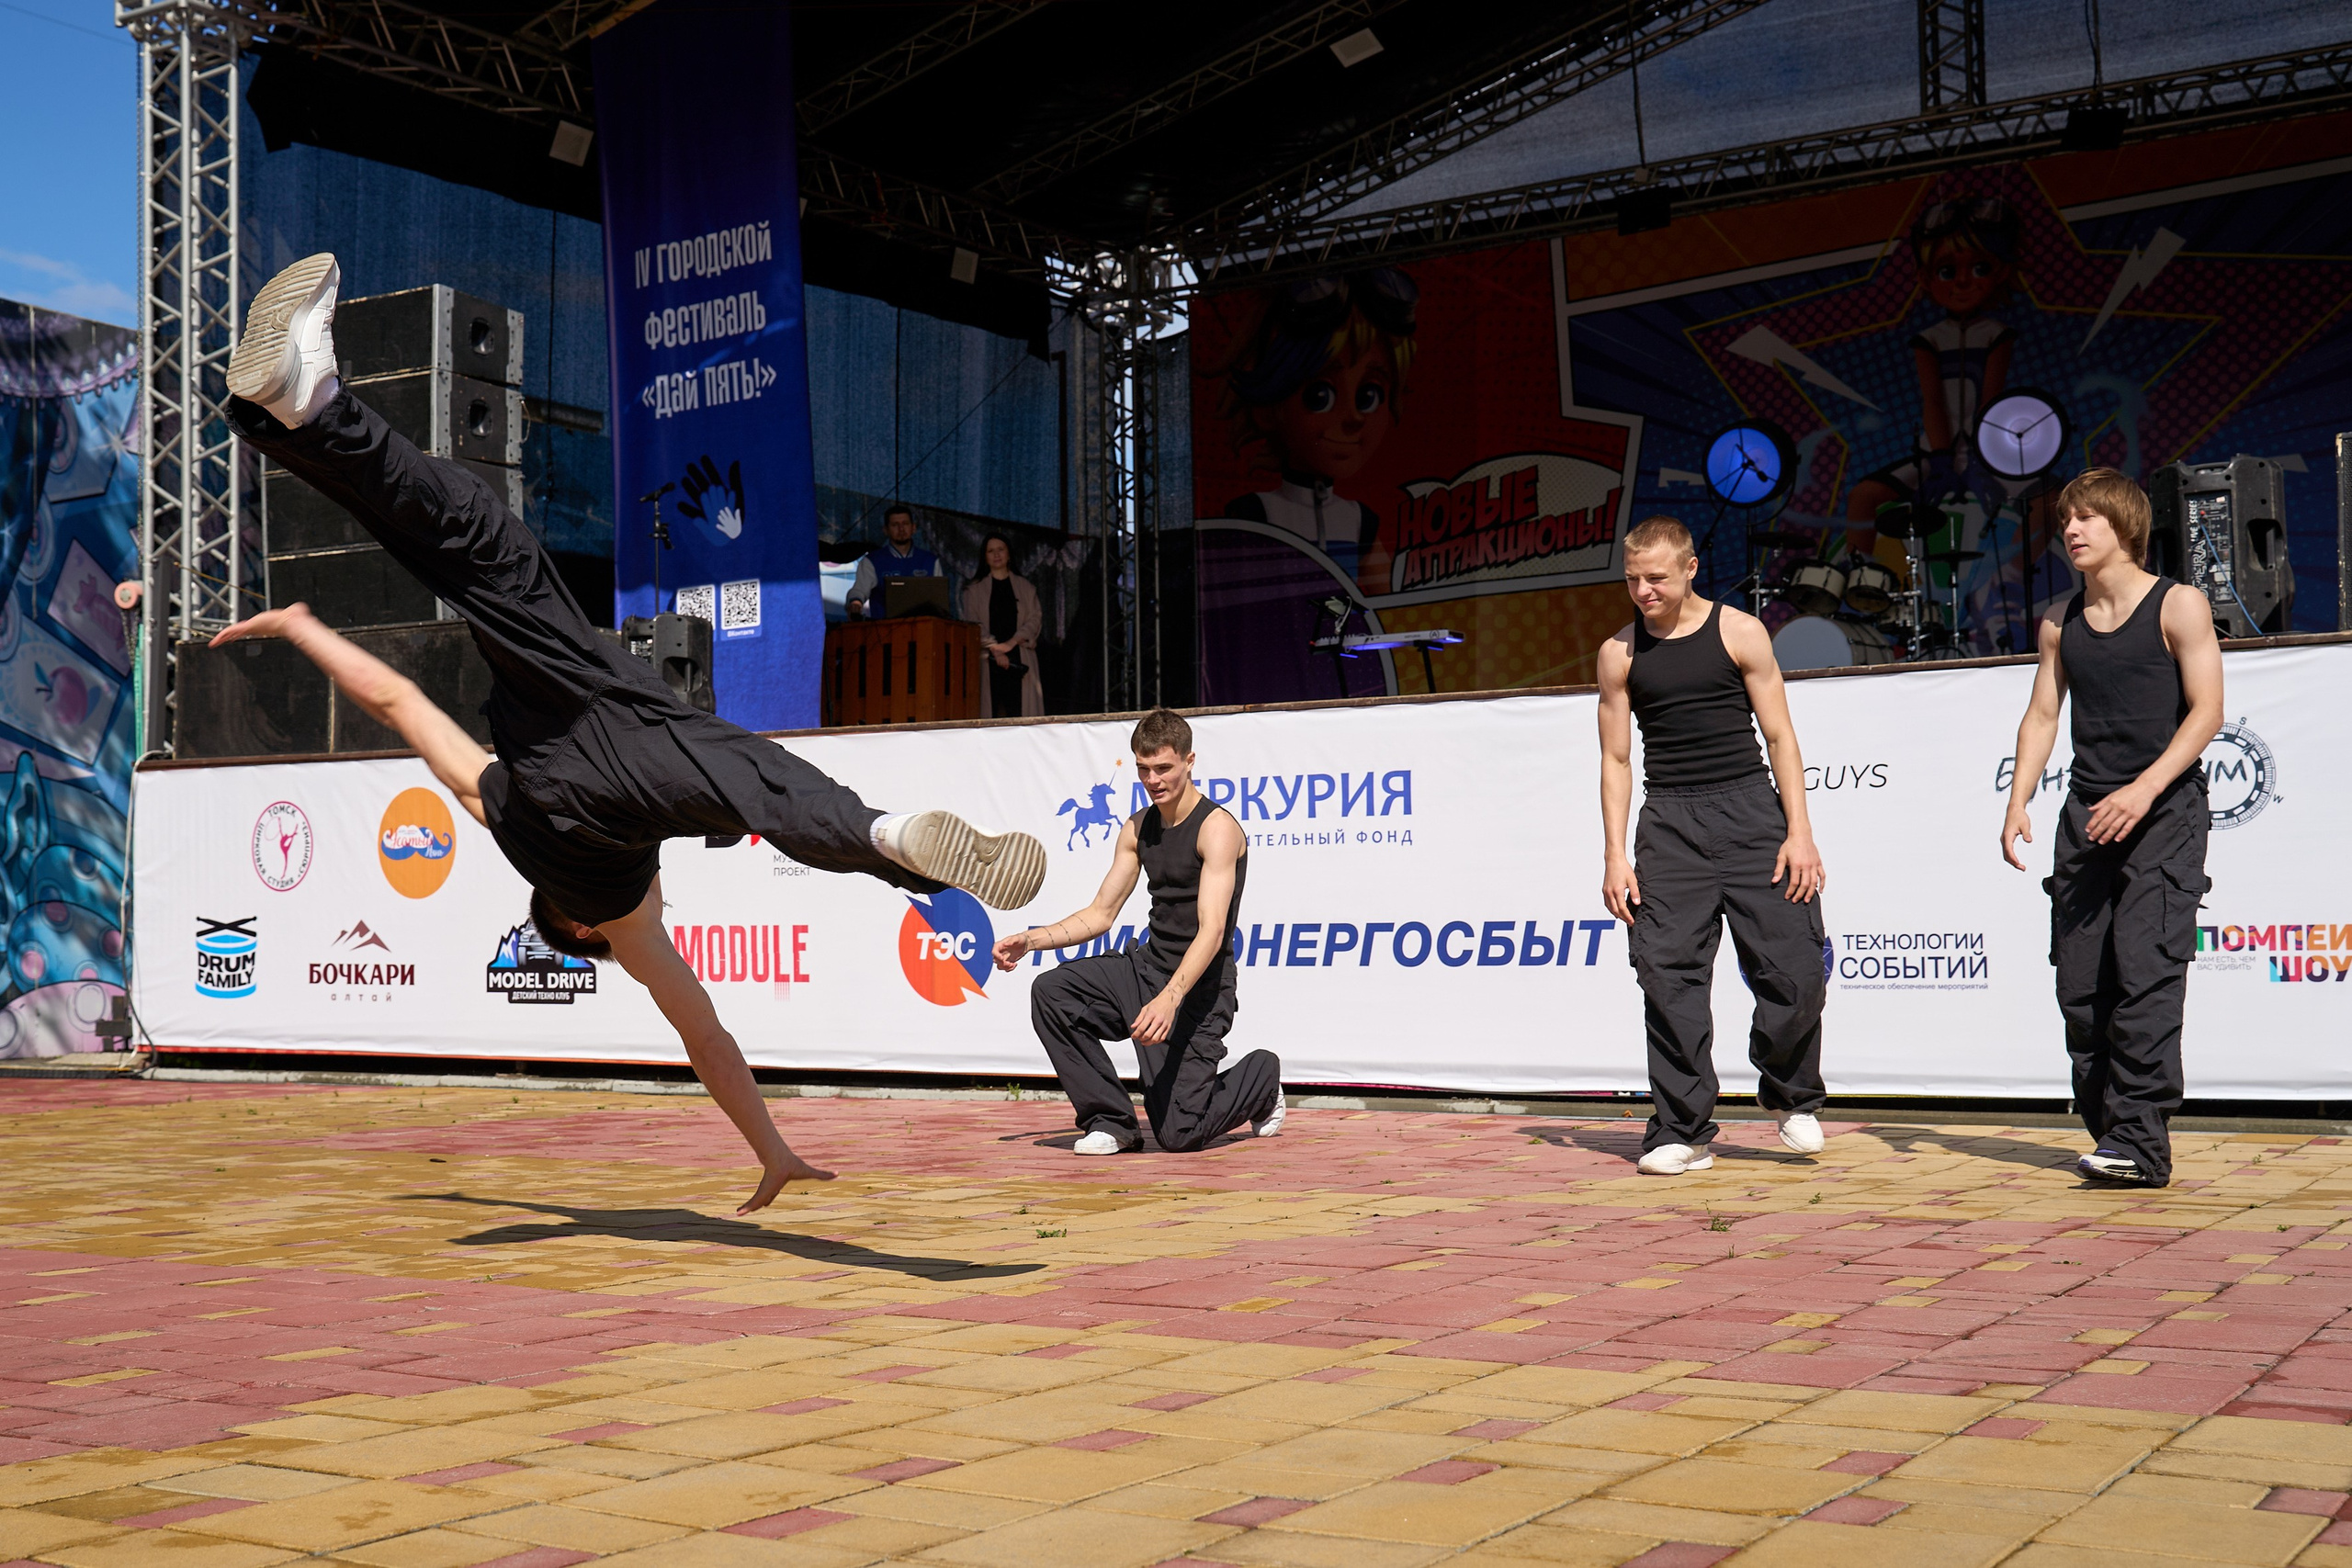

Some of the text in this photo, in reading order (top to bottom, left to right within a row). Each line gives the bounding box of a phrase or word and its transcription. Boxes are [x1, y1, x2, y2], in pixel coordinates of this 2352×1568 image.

[1398, 465, 1539, 550] НОВЫЕ
[1403, 487, 1624, 588] АТТРАКЦИОНЫ!
[1804, 763, 1889, 791] GUYS
[267, 805, 297, 818] ТОМСК
[1356, 829, 1413, 846] ФОНД
[773, 866, 810, 876] ПРОЕКТ
[916, 931, 977, 961] ТЭС
[1843, 932, 1984, 950] ТЕХНОЛОГИИ
[198, 952, 255, 972] DRUM
[673, 924, 809, 983] MODULE
[309, 963, 415, 986] БОЧКАРИ
[1839, 951, 1988, 979] СОБЫТИЙ
[2269, 955, 2352, 982] ШОУ
[198, 967, 254, 987] FAMILY
[489, 972, 594, 988] MODEL DRIVE
[1938, 983, 1988, 991] мероприятий
